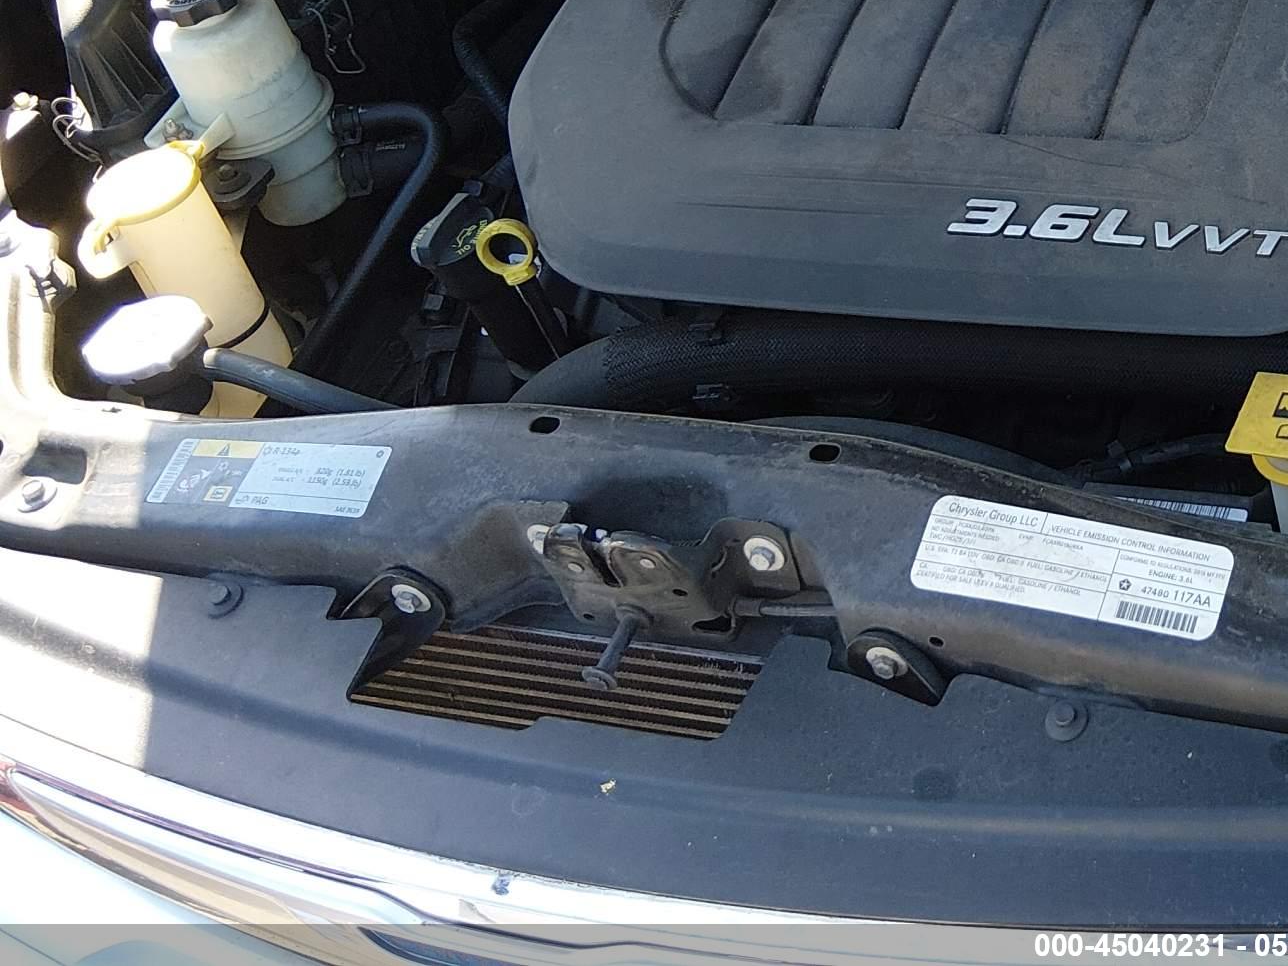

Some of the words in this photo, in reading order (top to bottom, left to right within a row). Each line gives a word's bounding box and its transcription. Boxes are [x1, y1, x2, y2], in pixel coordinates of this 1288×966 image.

[946, 197, 1145, 248] 3.6L
[455, 244, 471, 255] OIL
[249, 495, 270, 504] PAG
[948, 501, 987, 518] Chrysler
[987, 509, 1018, 525] Group
[1019, 514, 1038, 527] LLC
[1050, 524, 1081, 536] VEHICLE
[1082, 530, 1119, 544] EMISSION
[1120, 538, 1156, 551] CONTROL
[1157, 545, 1210, 562] INFORMATION
[1147, 568, 1177, 581] ENGINE:
[1140, 585, 1169, 598] 47480
[1172, 589, 1212, 607] 117AA
